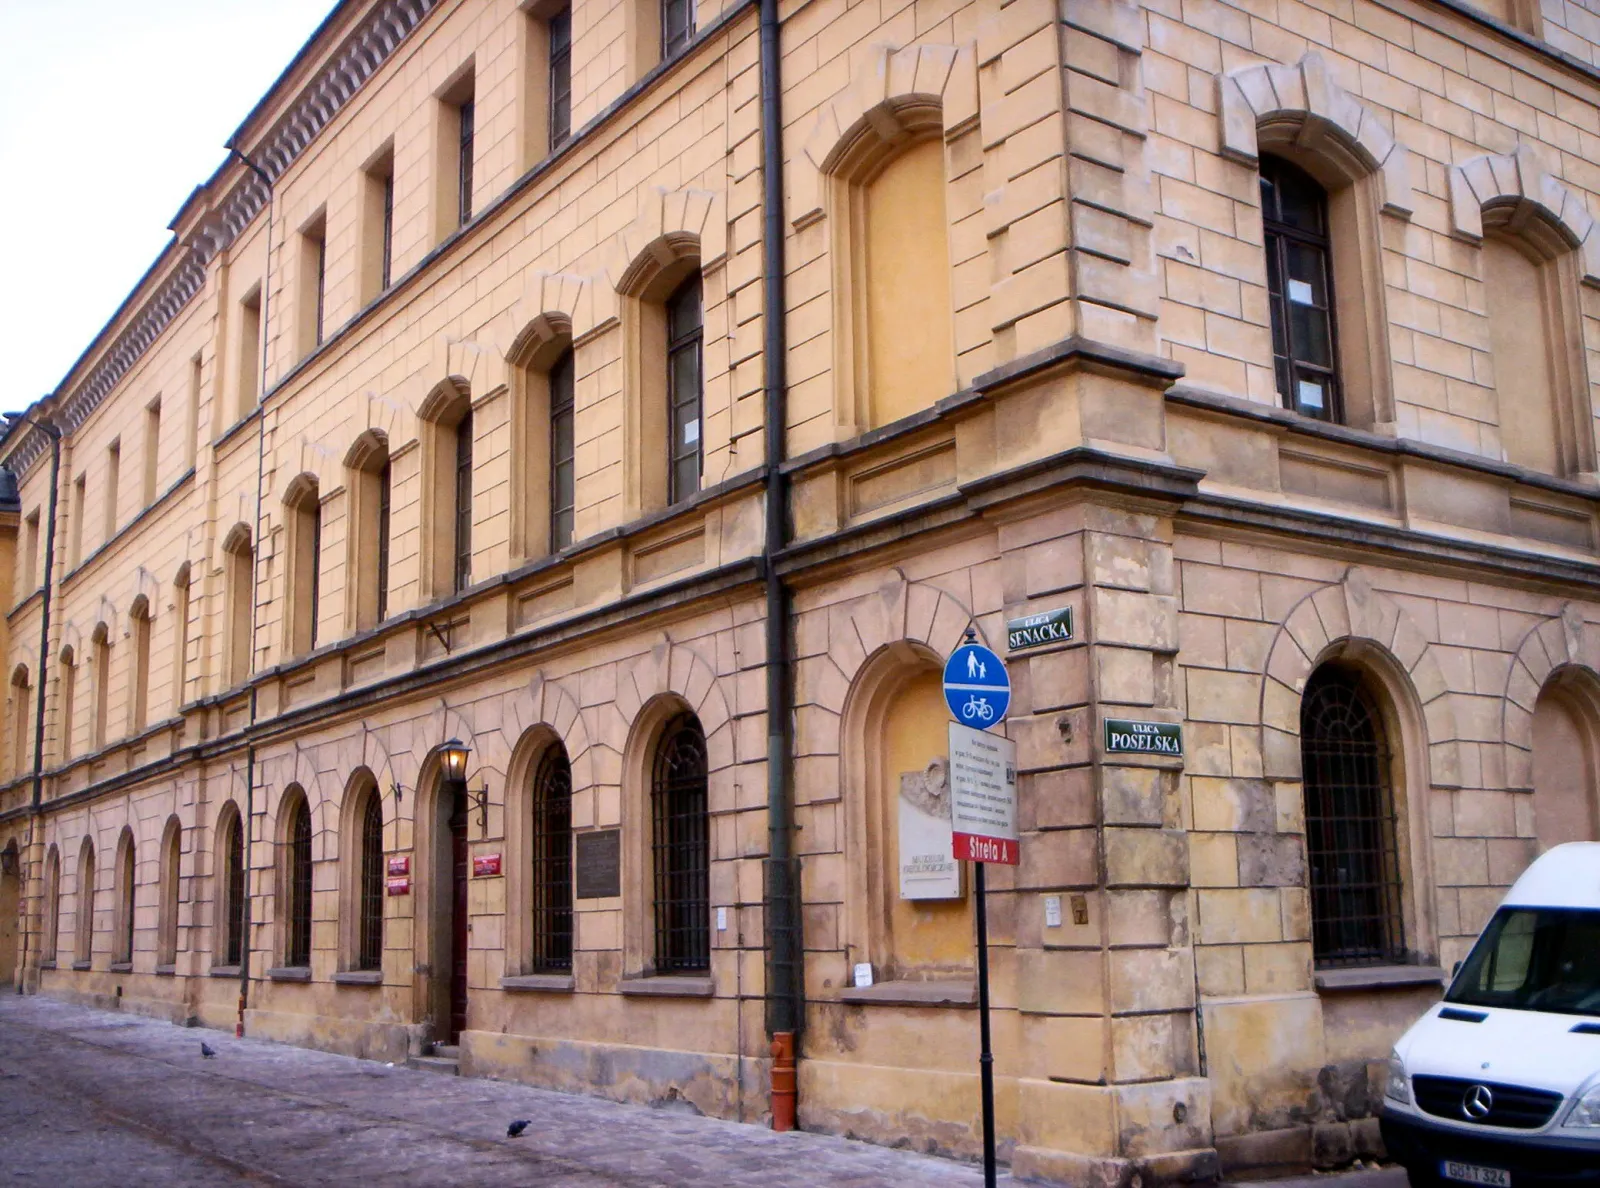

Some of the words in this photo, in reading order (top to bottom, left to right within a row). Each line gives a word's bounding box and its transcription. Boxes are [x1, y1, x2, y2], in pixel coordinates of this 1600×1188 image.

[1025, 615, 1050, 627] ULICA
[1009, 622, 1069, 648] SENACKA
[1132, 724, 1159, 734] ULICA
[1111, 732, 1179, 752] POSELSKA
[969, 835, 999, 861] Strefa
[1001, 841, 1008, 862] A
